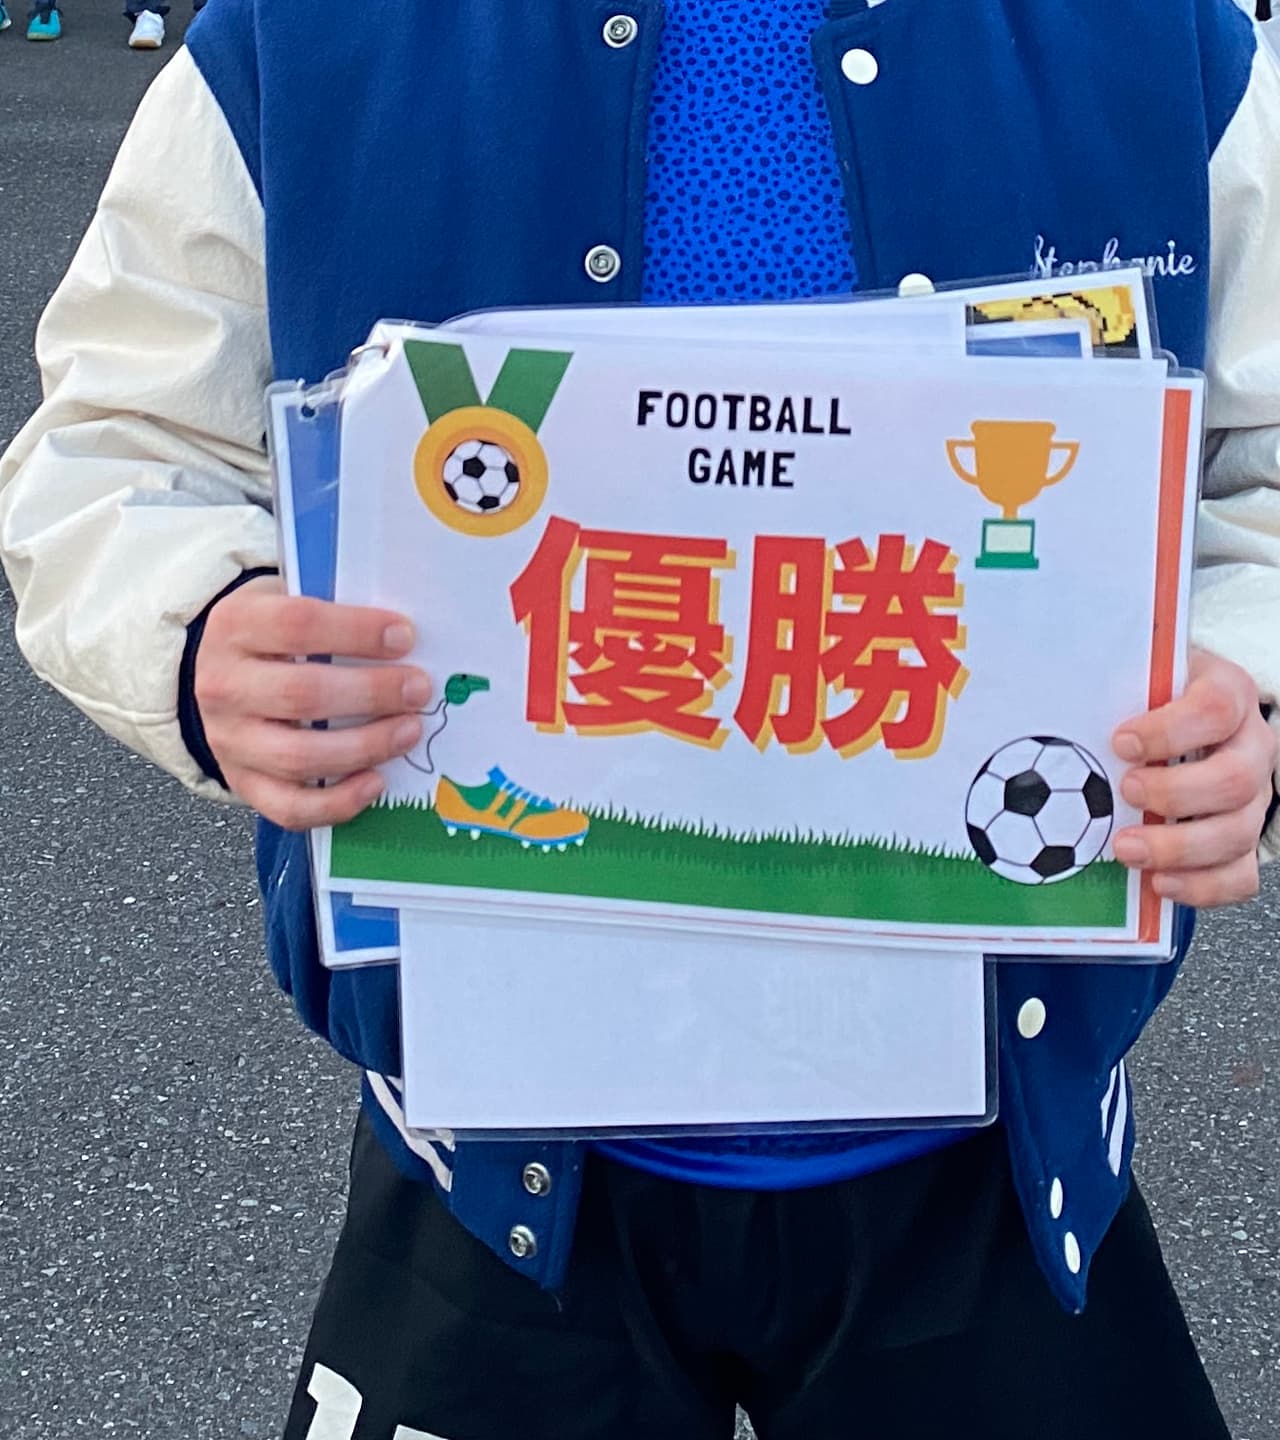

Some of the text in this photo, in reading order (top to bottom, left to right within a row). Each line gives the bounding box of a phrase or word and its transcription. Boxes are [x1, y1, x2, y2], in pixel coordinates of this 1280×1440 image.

[637, 390, 852, 435] FOOTBALL
[688, 447, 796, 488] GAME
[510, 515, 969, 760] 優勝
